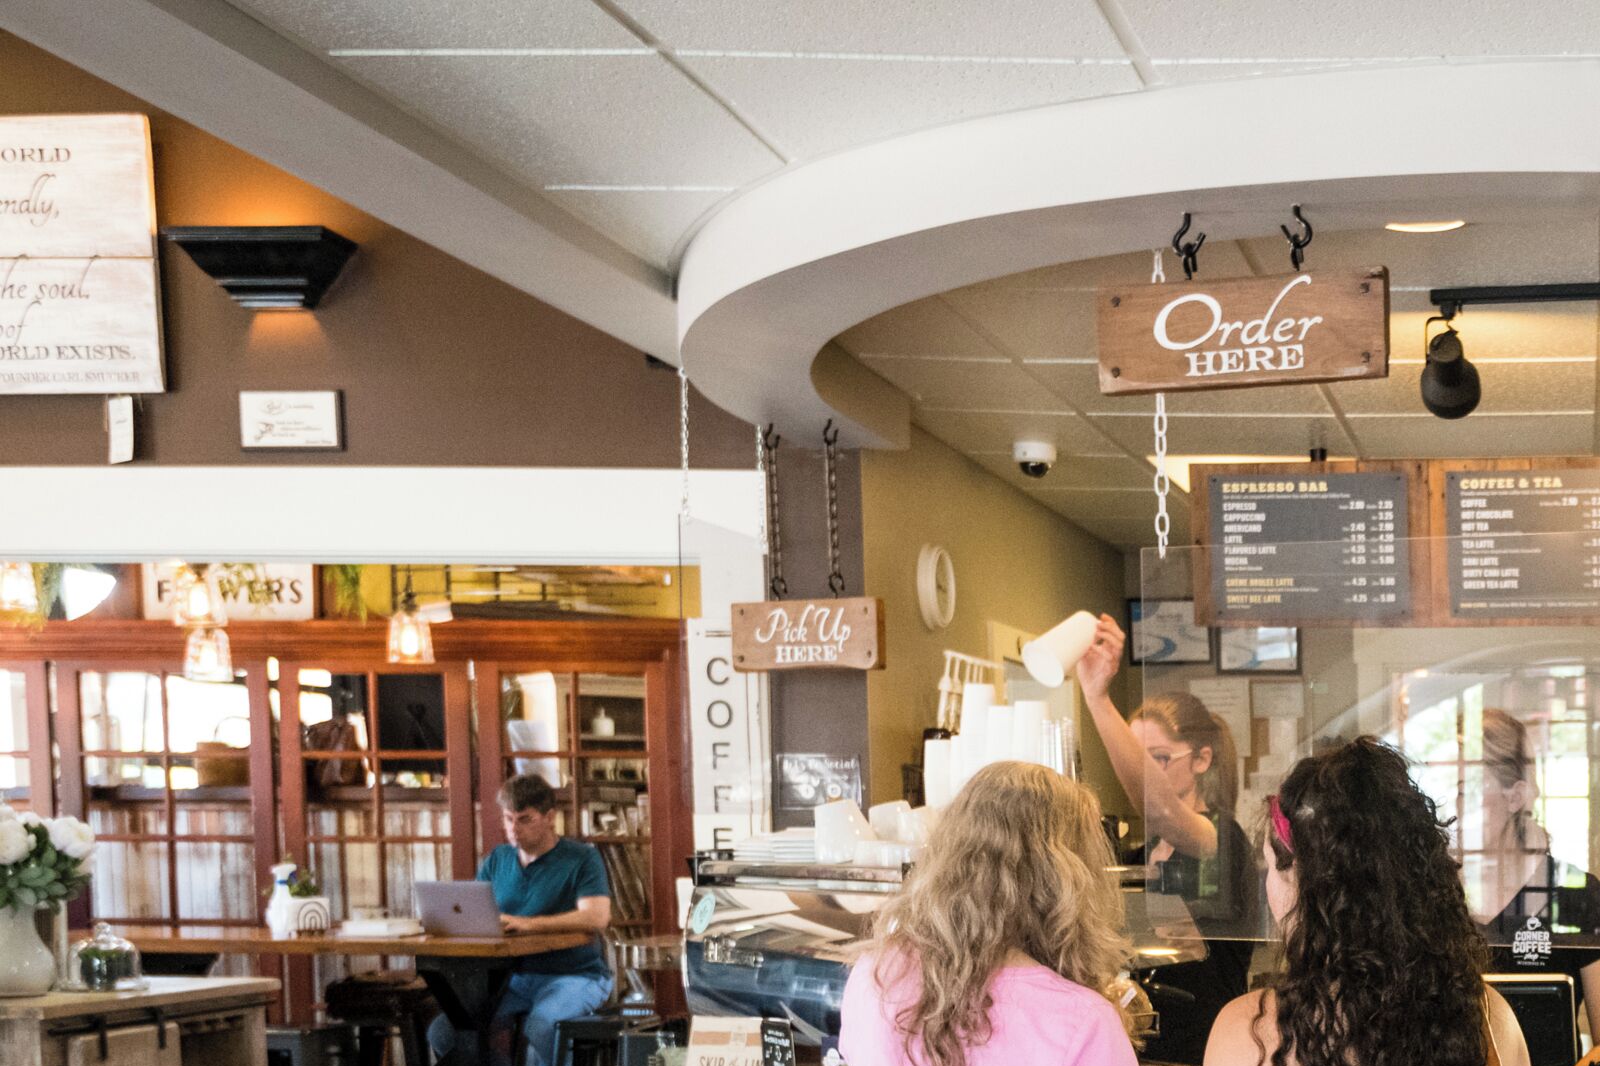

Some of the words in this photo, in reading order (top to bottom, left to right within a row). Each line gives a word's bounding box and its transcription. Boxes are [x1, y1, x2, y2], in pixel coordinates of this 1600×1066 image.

[0, 147, 71, 163] ORLD
[35, 254, 90, 300] soul.
[1153, 275, 1323, 350] Order
[56, 345, 136, 360] EXISTS.
[1185, 344, 1304, 377] HERE
[1222, 482, 1295, 493] ESPRESSO
[1299, 481, 1328, 493] BAR
[1460, 478, 1515, 490] COFFEE
[1518, 478, 1529, 489] &
[1533, 477, 1563, 489] TEA
[1223, 502, 1257, 511] ESPRESSO
[1461, 498, 1487, 508] COFFEE
[1224, 513, 1266, 522] CAPPUCCINO
[1224, 524, 1262, 533] AMERICANO
[1224, 535, 1243, 544] LATTE
[1475, 540, 1495, 549] LATTE
[1224, 546, 1257, 554] FLAVORED
[1258, 546, 1276, 554] LATTE
[1225, 557, 1248, 566] MOCHA
[157, 579, 303, 604] FWERS
[756, 604, 814, 643] Pick
[812, 607, 851, 651] Up
[775, 645, 838, 663] HERE
[706, 657, 733, 851] COFFEE
[1515, 931, 1550, 941] CORNER
[1512, 941, 1552, 954] COFFEE
